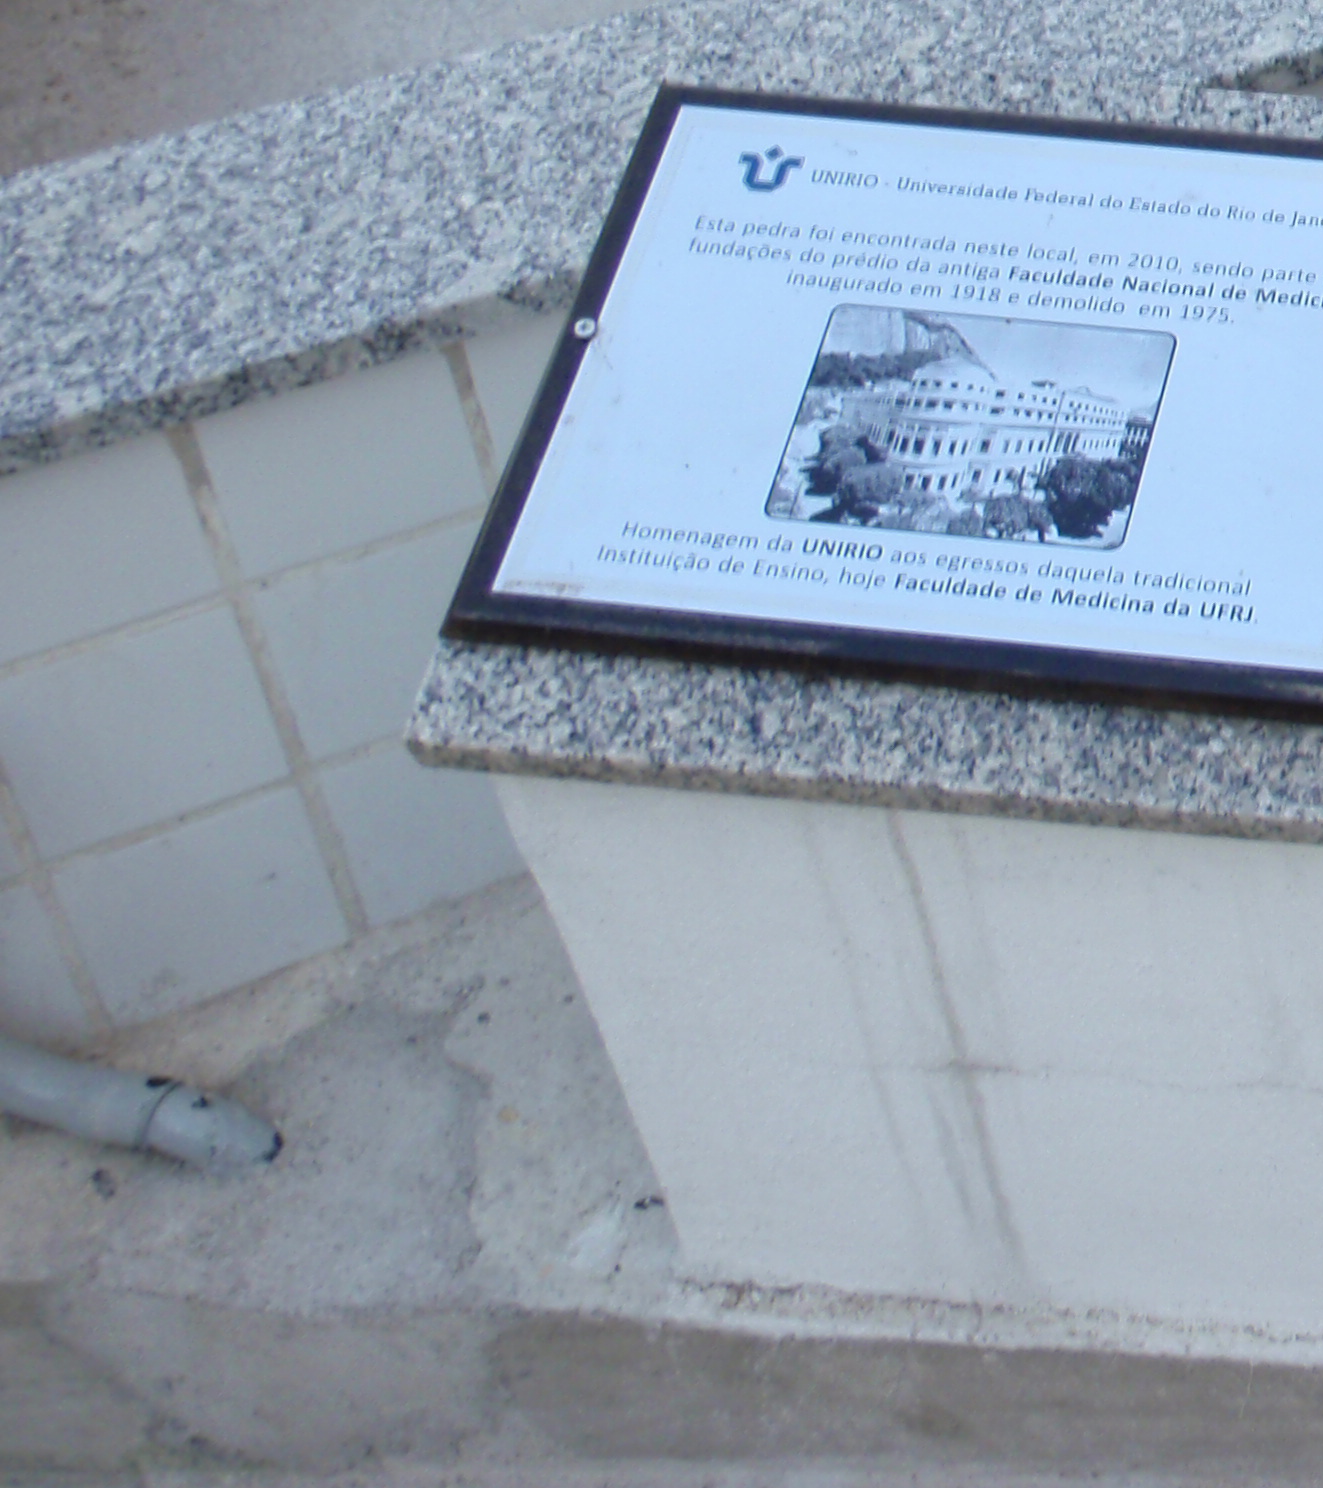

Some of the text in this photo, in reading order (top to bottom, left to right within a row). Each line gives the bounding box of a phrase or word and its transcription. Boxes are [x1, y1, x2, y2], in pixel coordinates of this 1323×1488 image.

[811, 169, 879, 189] UNIRIO
[897, 176, 1018, 201] Universidade
[1024, 187, 1094, 208] Federal
[1099, 194, 1123, 210] do
[1129, 196, 1191, 215] Estado
[1197, 202, 1221, 219] do
[1226, 205, 1256, 221] Rio
[1262, 208, 1285, 224] de
[689, 236, 791, 262] fundações
[799, 247, 825, 264] do
[831, 250, 899, 270] prédio
[906, 255, 930, 273] da
[938, 259, 1000, 280] antiga
[1008, 266, 1114, 289] Faculdade
[1122, 276, 1214, 299] Nacional
[1221, 285, 1246, 301] de
[695, 214, 735, 233] Esta
[741, 221, 801, 239] pedra
[808, 224, 835, 242] foi
[841, 230, 956, 252] encontrada
[963, 238, 1019, 257] neste
[1027, 243, 1078, 264] local,
[1088, 252, 1119, 266] em
[1127, 252, 1182, 275] 2010,
[1192, 259, 1253, 278] sendo
[1261, 265, 1316, 284] parte
[786, 269, 1235, 324] inaugurado em 1918 e demolido em 1975.
[597, 544, 1258, 624] Instituição de Ensino, hoje Faculdade de Medicina da UFRJ.
[621, 521, 1251, 596] Homenagem da UNIRIO aos egressos daquela tradicional
